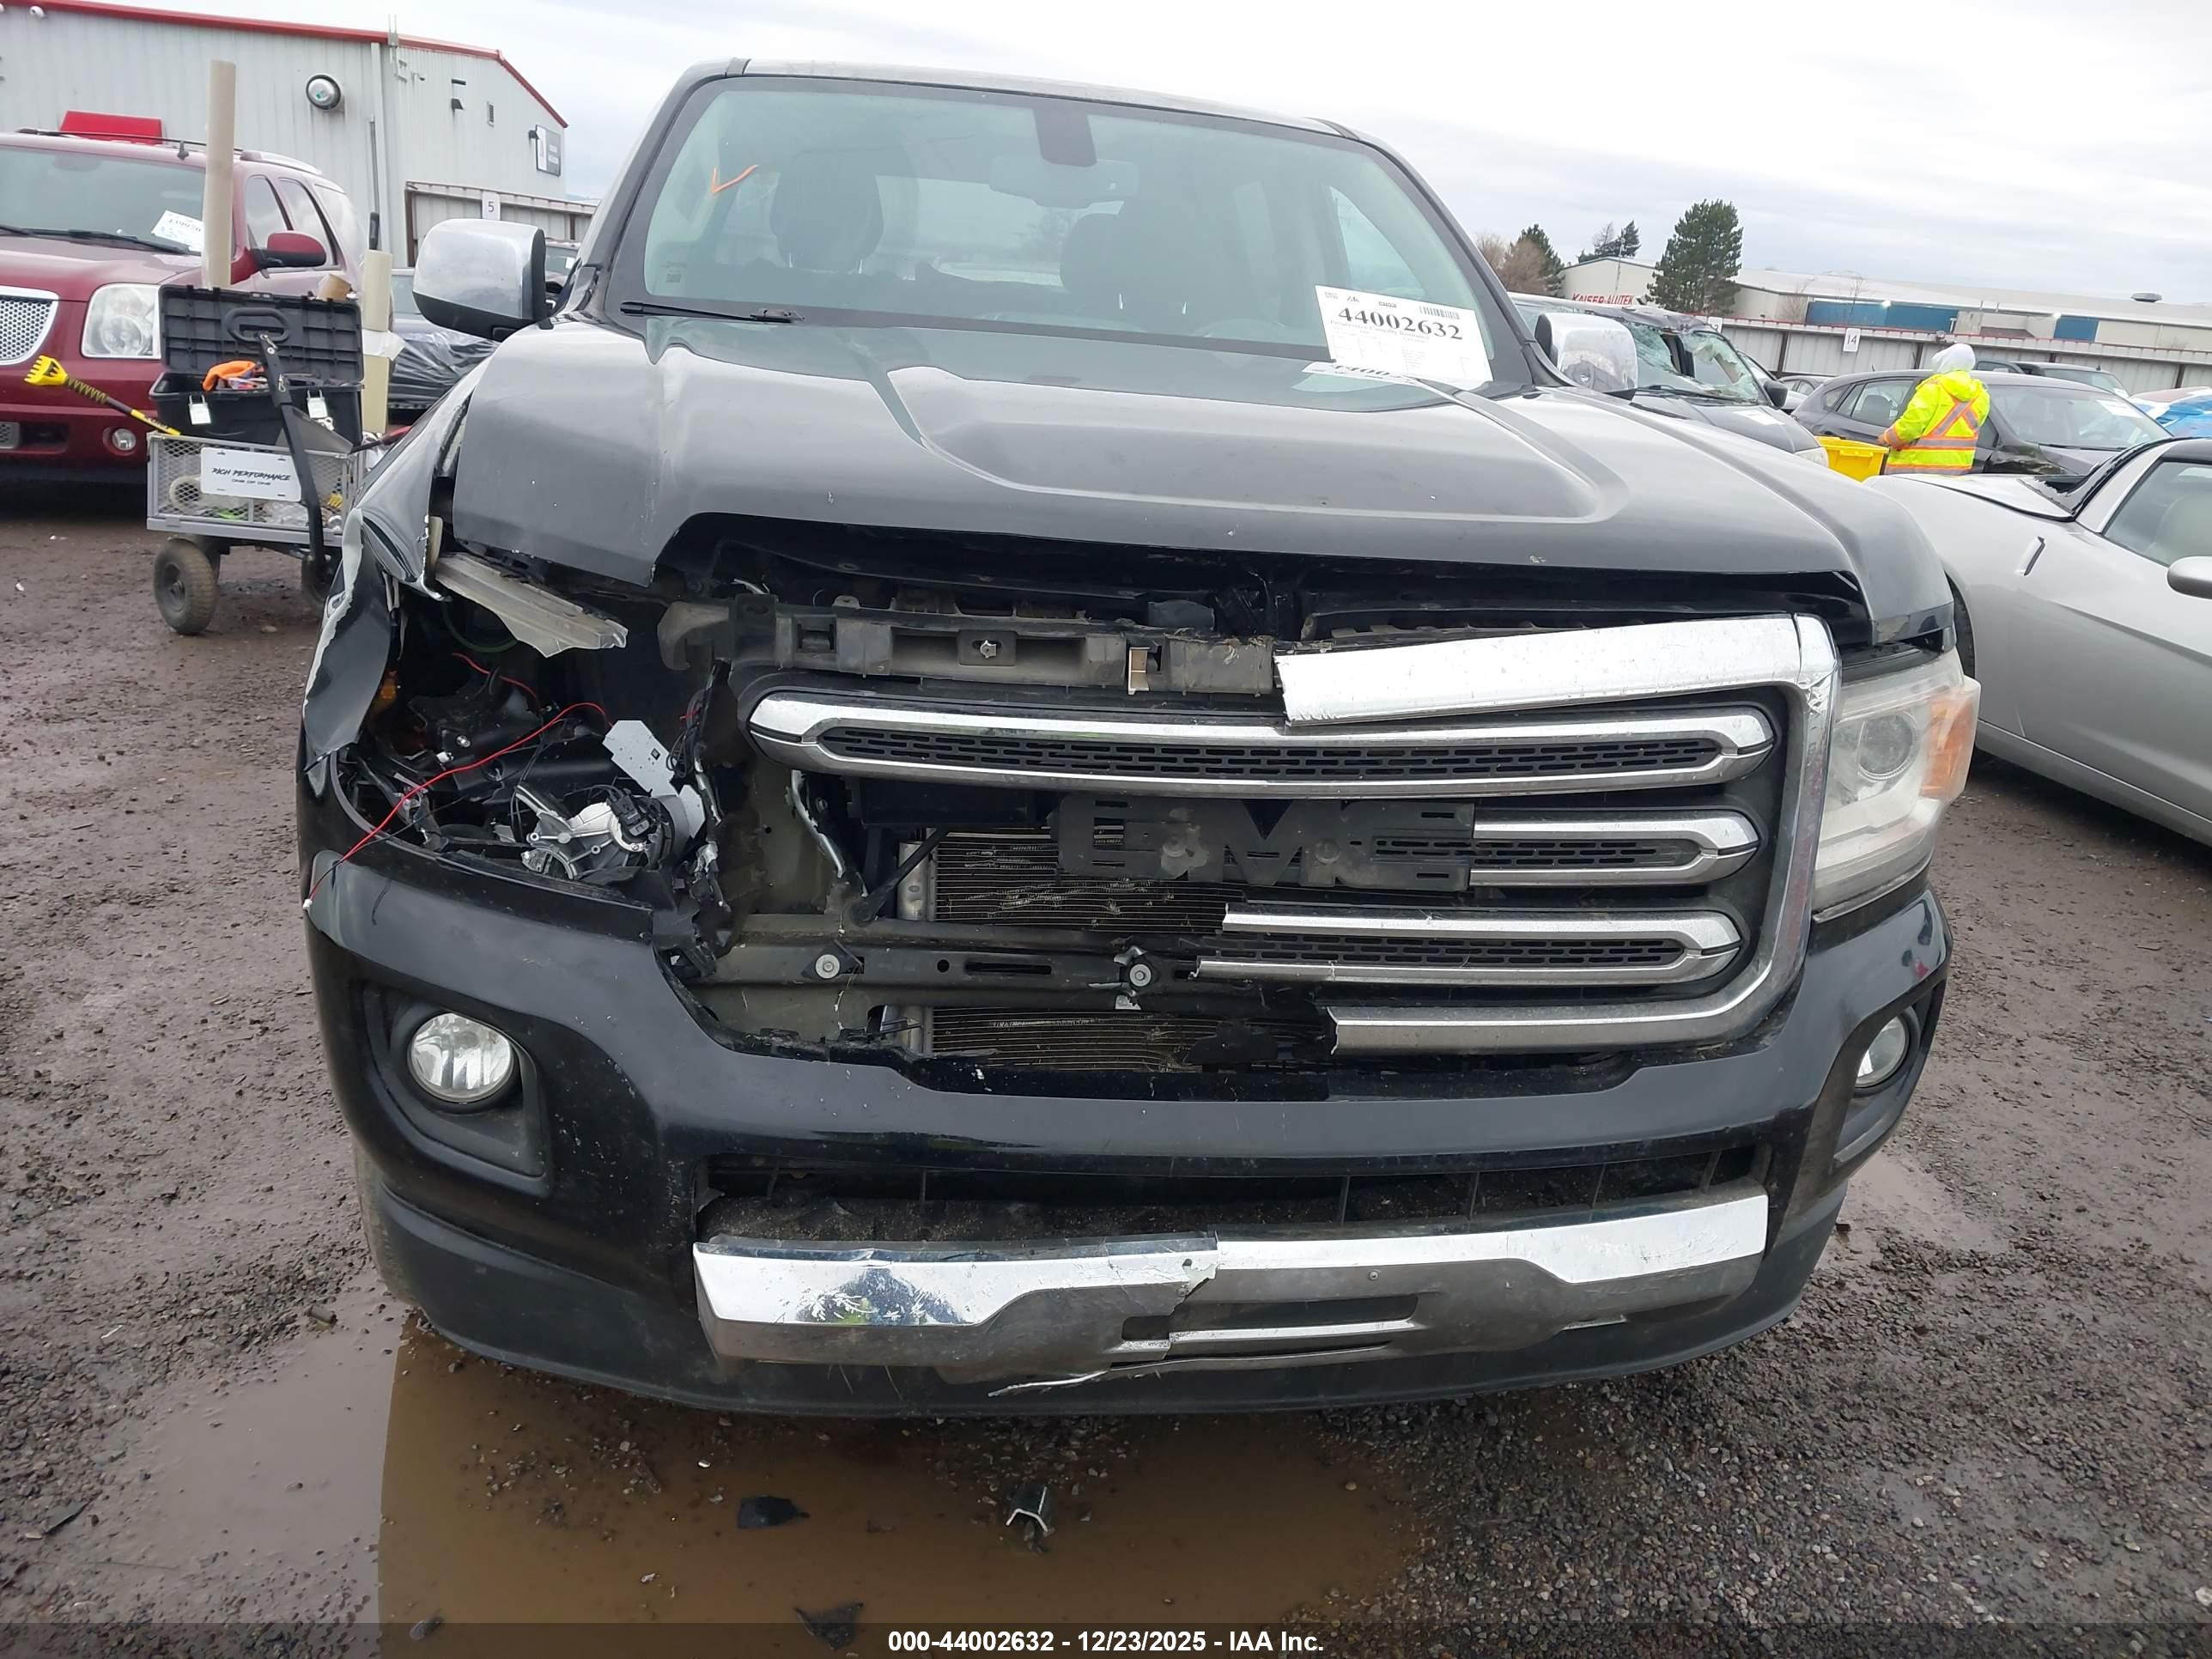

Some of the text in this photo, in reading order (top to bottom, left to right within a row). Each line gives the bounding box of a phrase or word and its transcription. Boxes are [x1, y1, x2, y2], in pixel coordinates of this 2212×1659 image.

[487, 200, 495, 213] 5
[1337, 307, 1463, 340] 44002632
[1847, 334, 1857, 344] 14
[233, 469, 291, 481] PERFORMANCE
